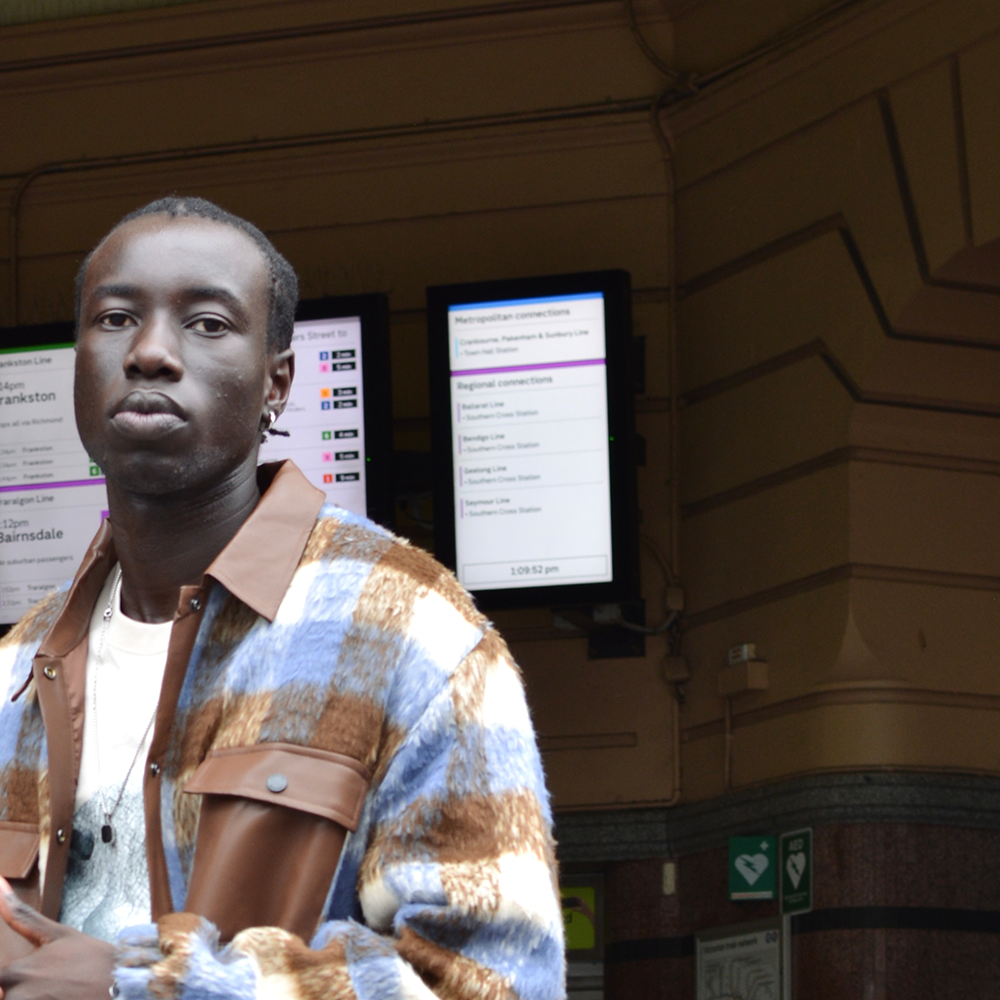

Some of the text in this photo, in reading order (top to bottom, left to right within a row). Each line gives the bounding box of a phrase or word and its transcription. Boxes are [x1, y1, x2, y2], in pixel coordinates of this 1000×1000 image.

[455, 308, 570, 325] Metropolitan connections
[308, 330, 336, 340] Street
[457, 376, 552, 391] Regional connections
[511, 563, 559, 576] 1:09:52 pm
